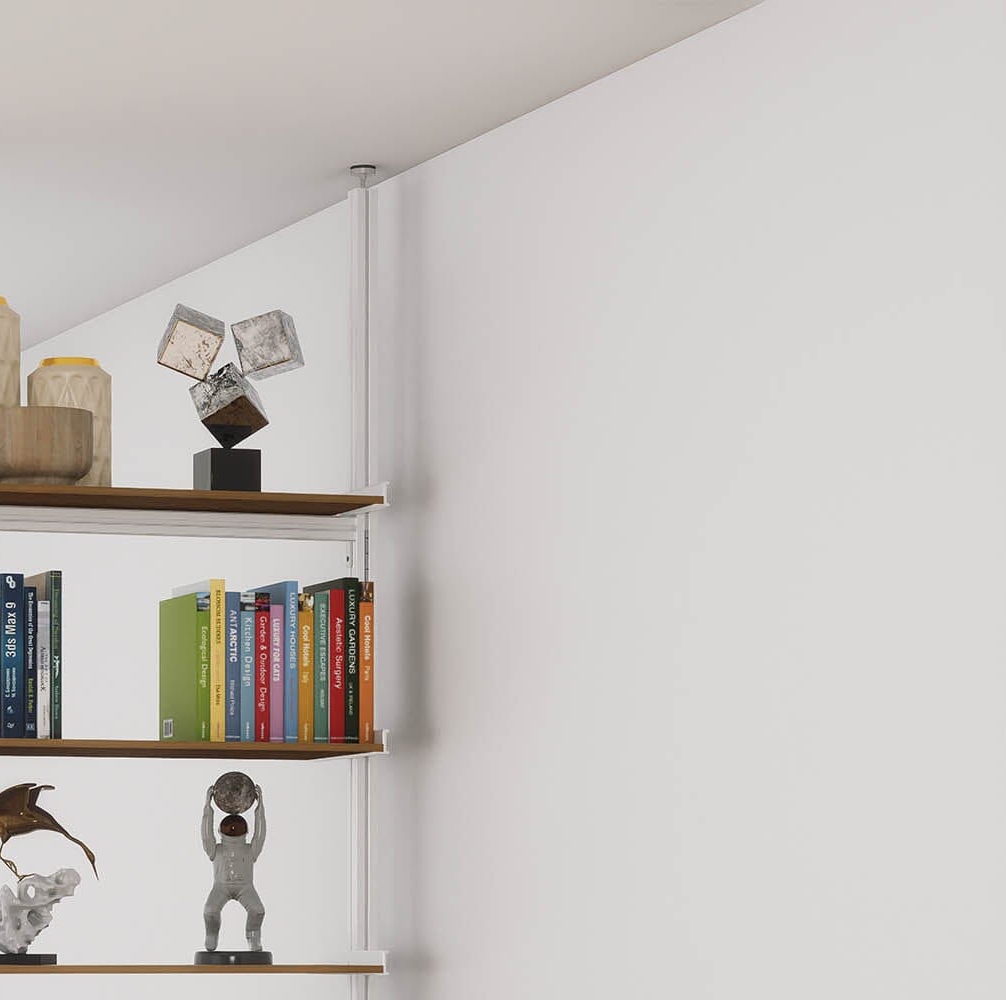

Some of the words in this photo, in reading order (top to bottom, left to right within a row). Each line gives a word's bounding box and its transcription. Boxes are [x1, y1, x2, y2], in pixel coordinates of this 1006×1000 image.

[348, 589, 356, 626] LUXURY
[5, 612, 16, 635] Max
[229, 610, 237, 662] ANTARCTIC
[243, 617, 252, 652] Kitchen
[259, 616, 267, 642] Garden
[302, 625, 310, 641] Cool
[5, 638, 16, 657] 3ds
[199, 626, 208, 662] Ecological
[302, 643, 310, 667] Hotels
[348, 629, 356, 674] GARDENS
[199, 664, 208, 688] Design
[243, 656, 252, 687] Design
[259, 653, 267, 684] Outdoor
[334, 655, 343, 689] Surgery
[258, 687, 267, 711] Design
